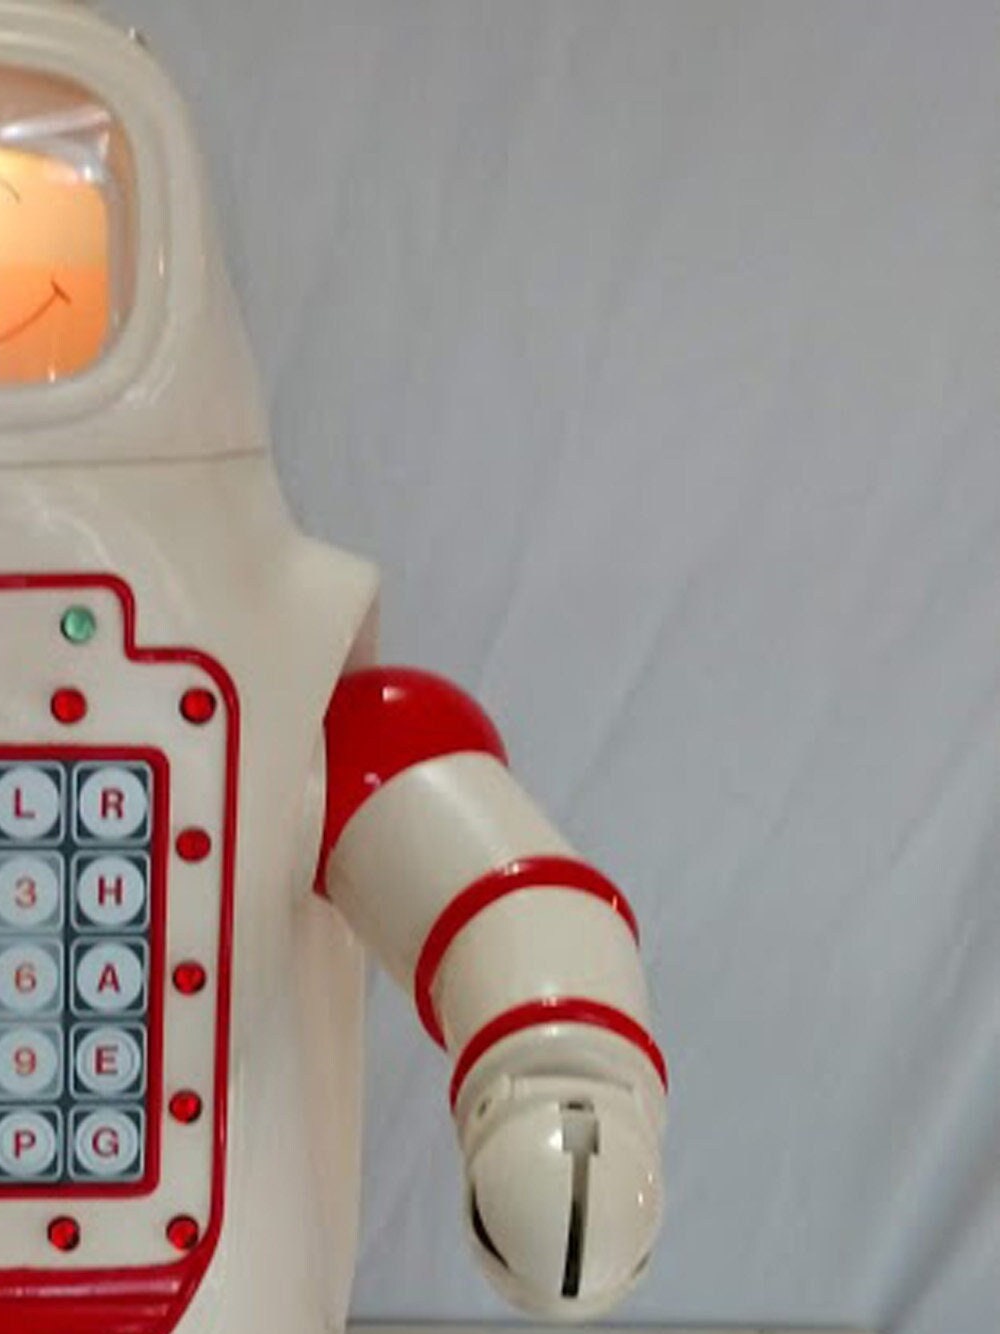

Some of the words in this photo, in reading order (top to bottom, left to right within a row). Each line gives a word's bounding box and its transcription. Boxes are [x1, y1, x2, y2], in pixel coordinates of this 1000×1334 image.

[13, 788, 35, 818] L
[99, 789, 126, 819] R
[14, 878, 37, 908] 3
[97, 877, 123, 906] H
[13, 964, 36, 993] 6
[97, 964, 120, 993] A
[13, 1047, 37, 1075] 9
[94, 1046, 118, 1075] E
[13, 1130, 36, 1159] P
[92, 1128, 120, 1157] G
